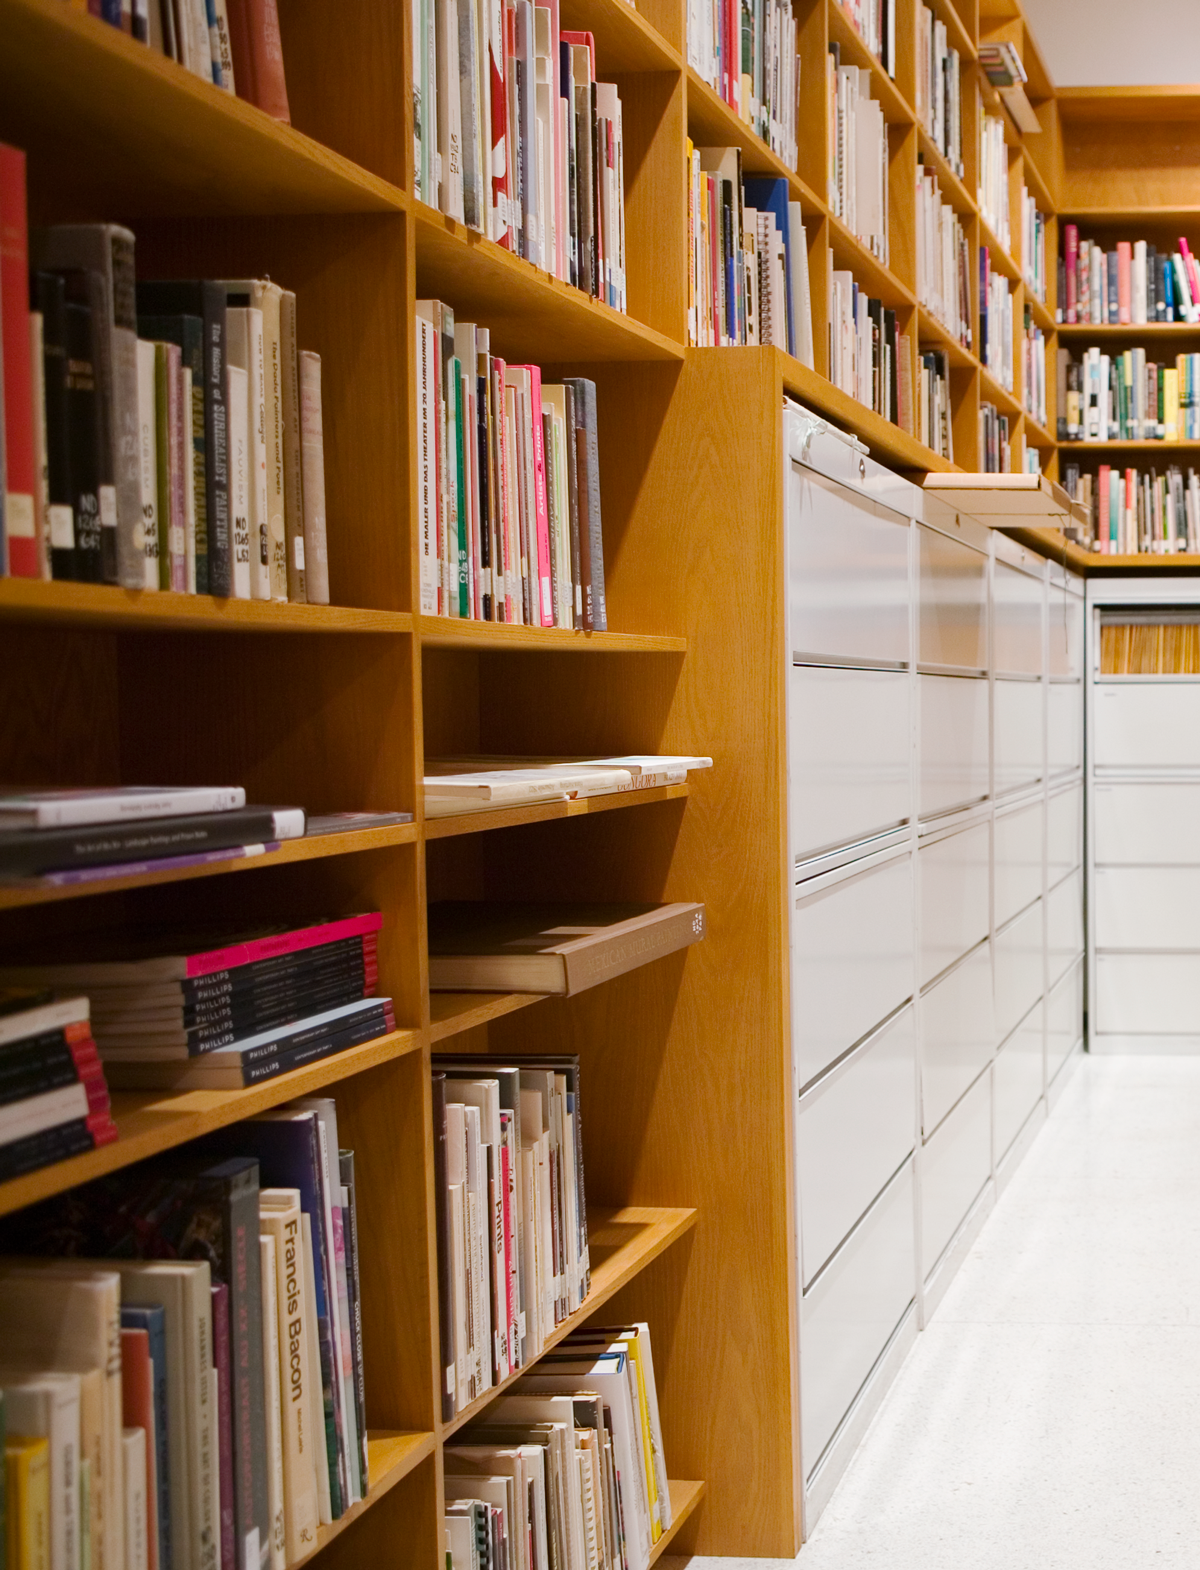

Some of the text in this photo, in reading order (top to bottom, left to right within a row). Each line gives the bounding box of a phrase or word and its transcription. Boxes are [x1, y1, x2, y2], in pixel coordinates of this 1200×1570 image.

[420, 322, 428, 391] JAHRHUNDERT
[421, 392, 428, 406] 20
[421, 407, 428, 420] IM
[211, 323, 229, 550] The History of SURREALIST PAINTING
[421, 421, 429, 462] THEATER
[142, 424, 150, 489] CUBISM
[421, 463, 429, 482] DAS
[234, 516, 248, 531] ND
[422, 506, 430, 540] MALER
[194, 971, 230, 988] PHILLIPS
[198, 984, 232, 1000] PHILLIPS
[196, 996, 231, 1012] PHILLIPS
[196, 1007, 232, 1024] PHILLIPS
[198, 1020, 234, 1038] PHILLIPS
[200, 1034, 235, 1052] PHILLIPS
[249, 1044, 278, 1060] PHILLIPS
[250, 1062, 280, 1078] PHILLIPS
[495, 1200, 505, 1254] Prints
[284, 1218, 306, 1402] Francis Bacon
[198, 1316, 208, 1374] JOHANNES
[296, 1407, 304, 1432] Michel
[202, 1426, 210, 1446] THE
[203, 1474, 210, 1486] OF
